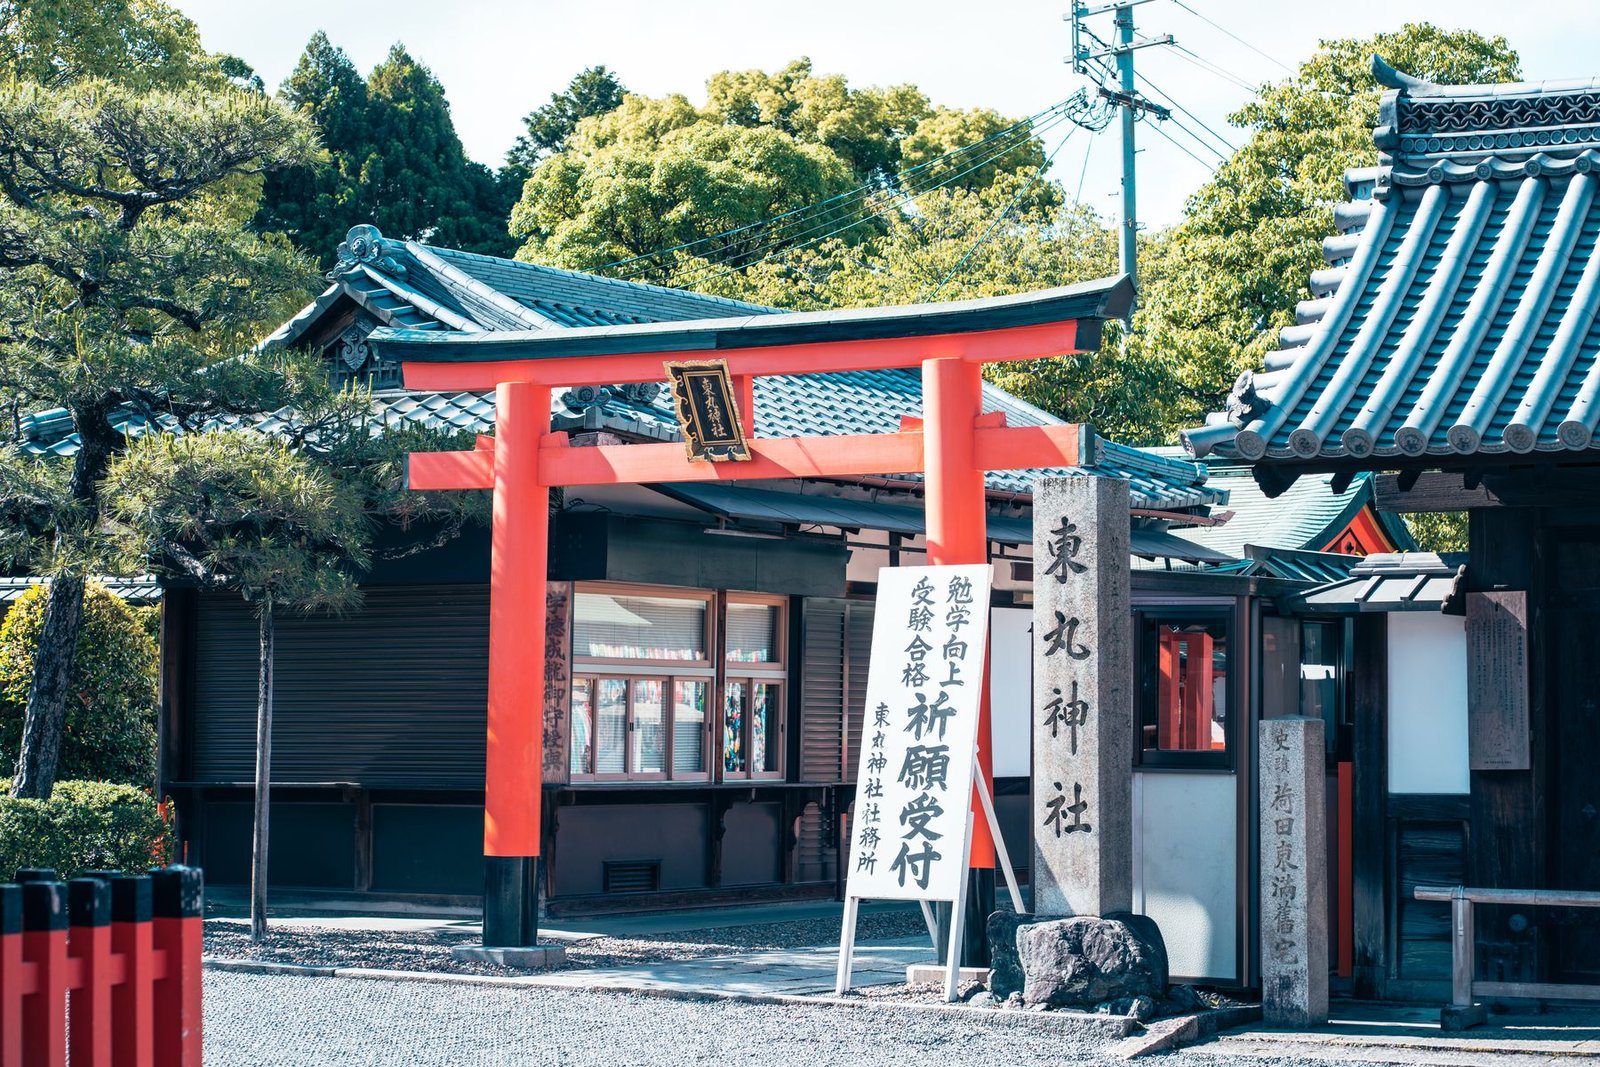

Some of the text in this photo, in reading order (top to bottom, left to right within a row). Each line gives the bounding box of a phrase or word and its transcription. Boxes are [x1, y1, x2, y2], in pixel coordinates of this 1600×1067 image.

[701, 377, 728, 438] 東丸神社
[901, 575, 936, 688] 受験合格
[938, 575, 974, 688] 勉学向上
[1042, 516, 1093, 839] 東丸神社
[856, 701, 891, 877] 東丸神社社務所
[889, 690, 958, 891] 祈願受付
